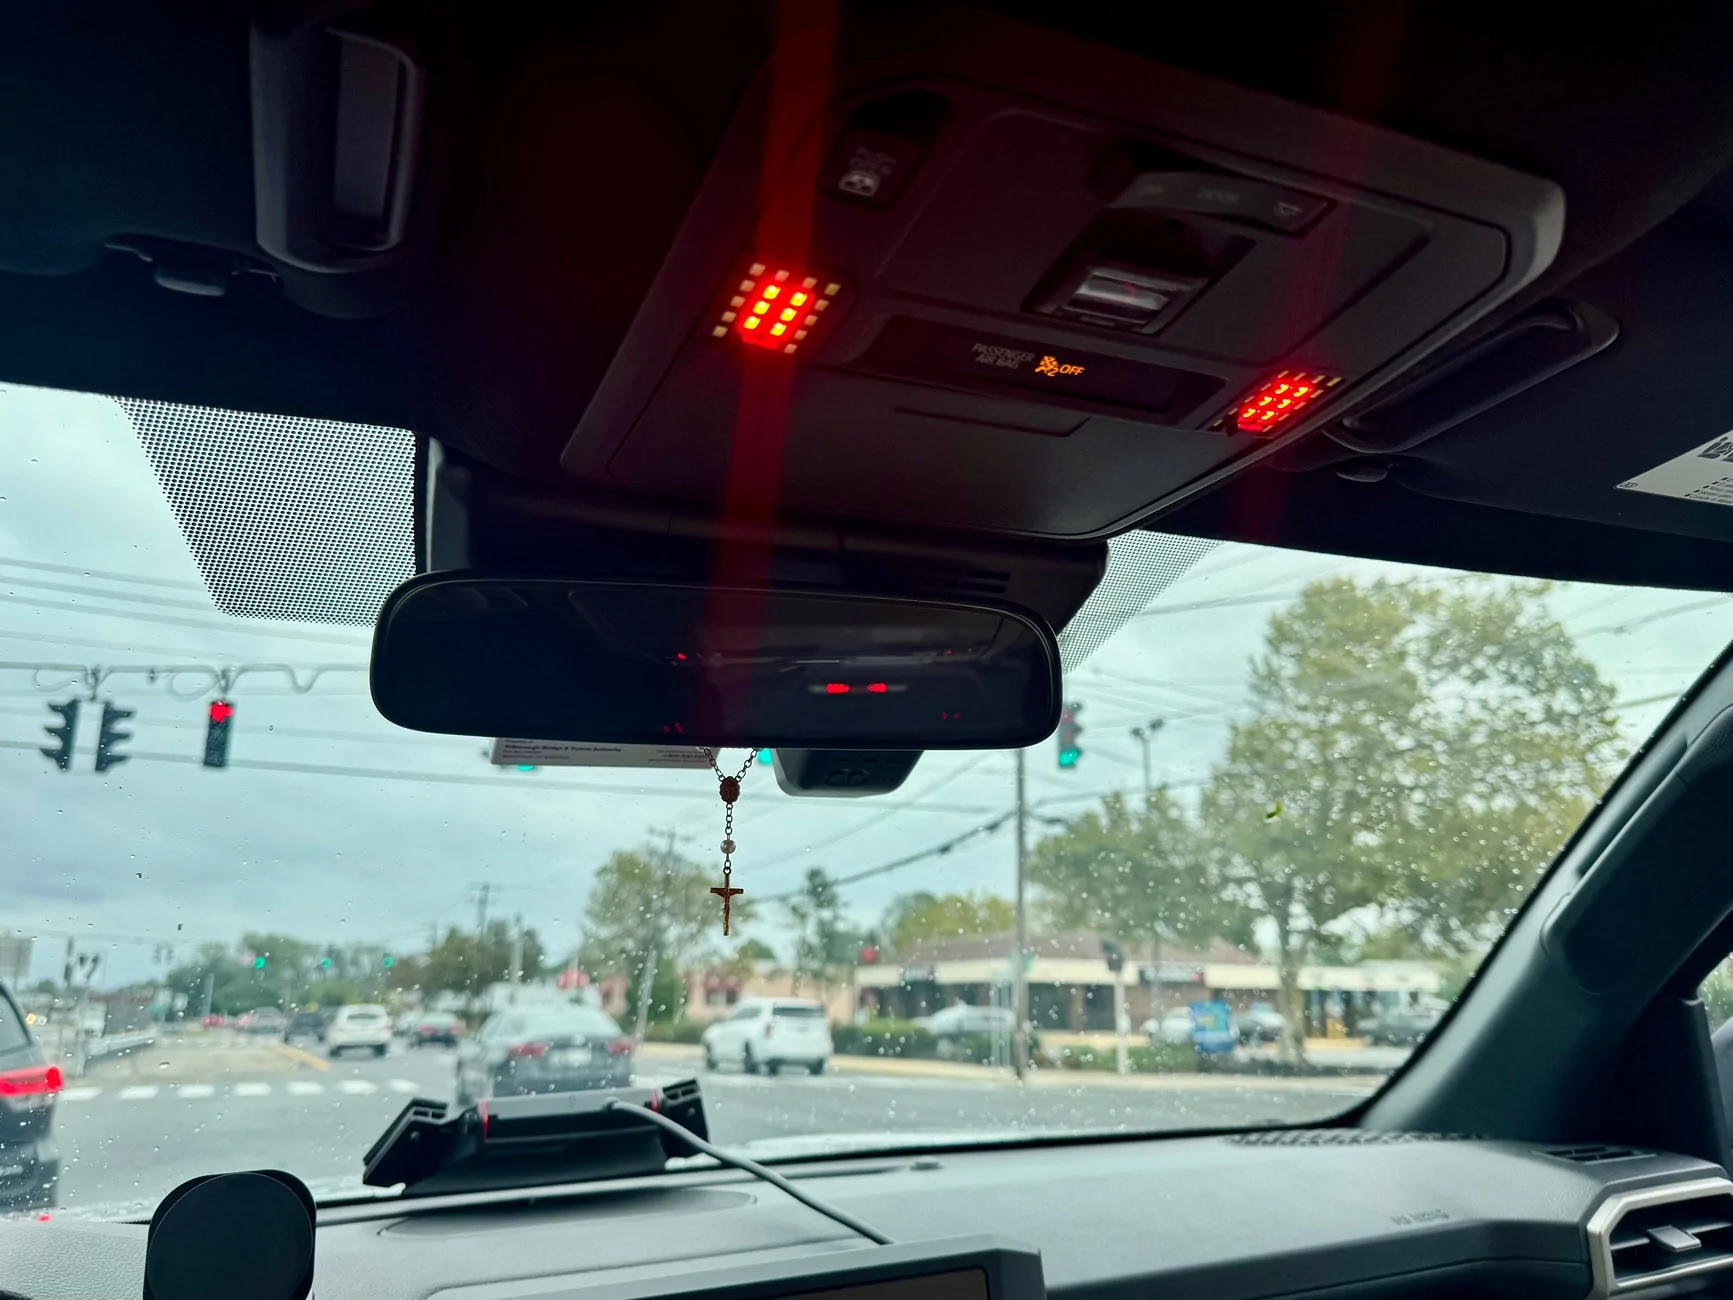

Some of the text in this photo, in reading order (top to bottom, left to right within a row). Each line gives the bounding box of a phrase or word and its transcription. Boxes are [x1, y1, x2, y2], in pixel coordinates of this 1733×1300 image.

[972, 343, 1035, 362] PASSENGER
[976, 354, 1019, 369] AIR BAG
[1059, 364, 1086, 375] OFF
